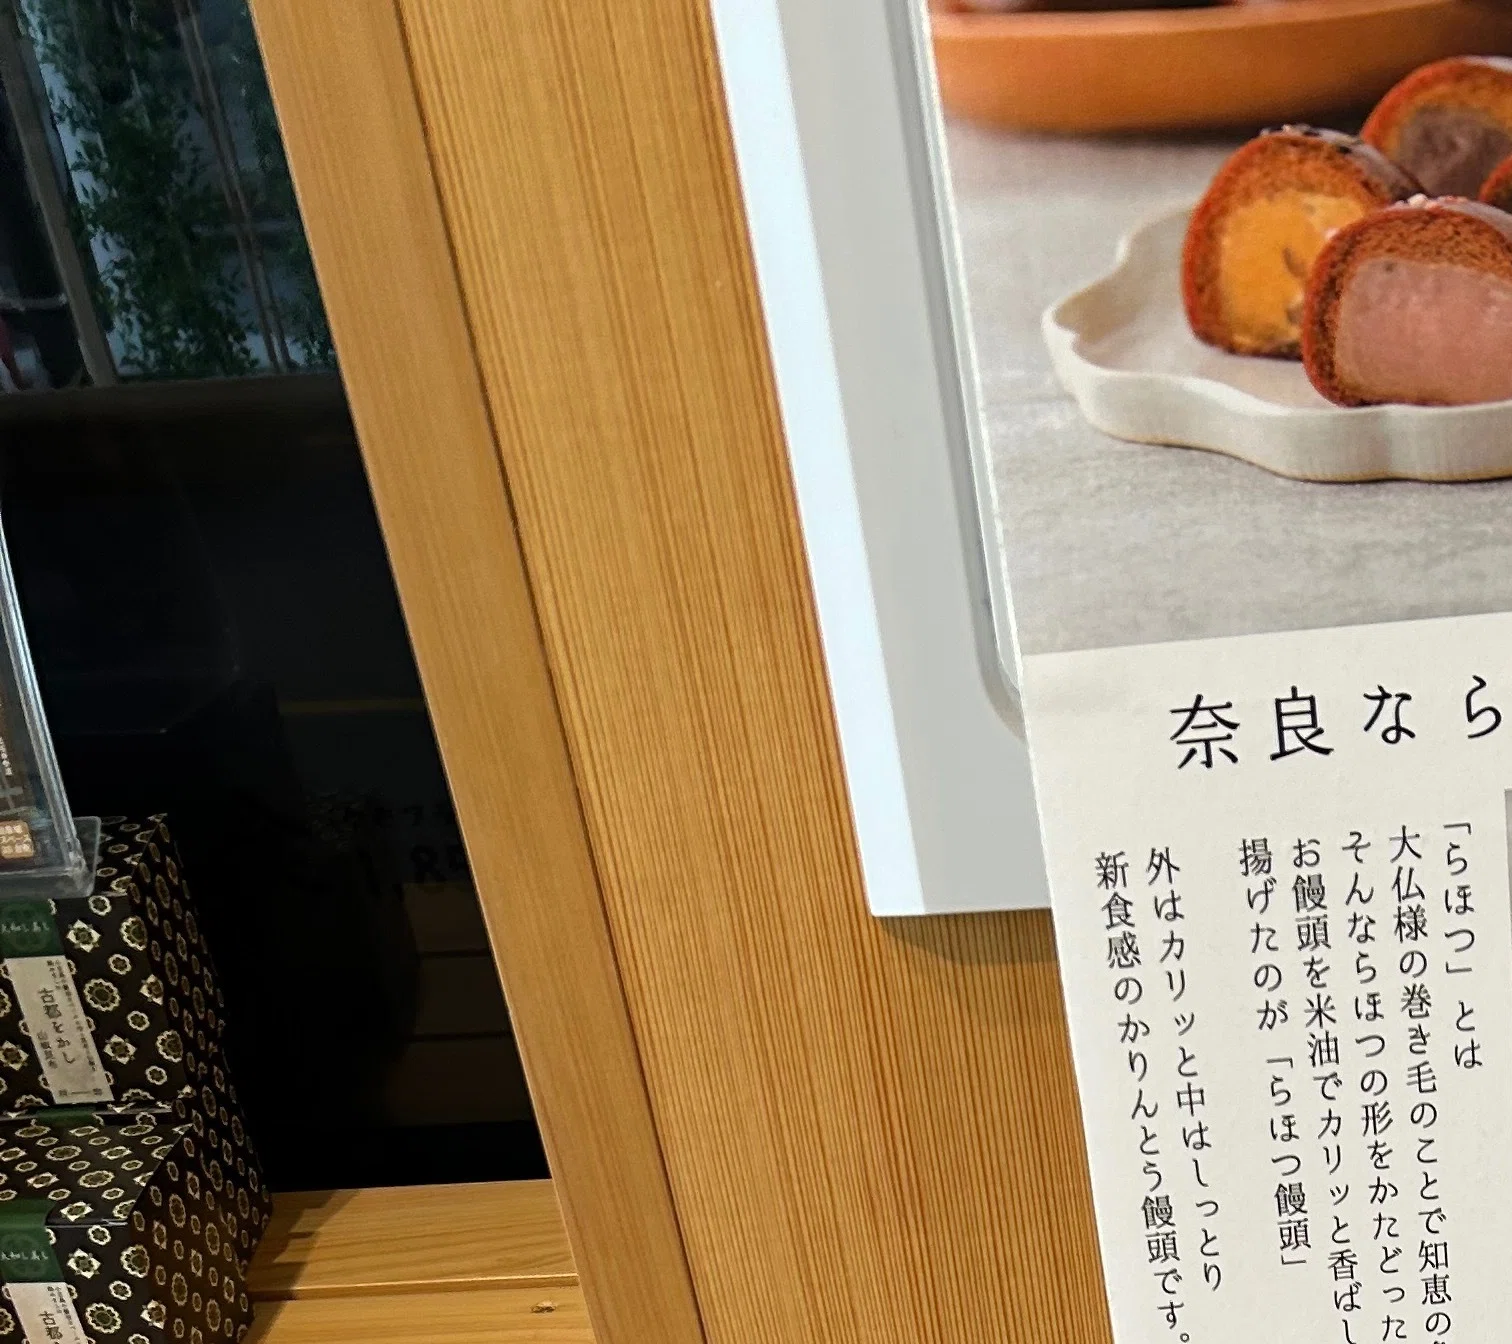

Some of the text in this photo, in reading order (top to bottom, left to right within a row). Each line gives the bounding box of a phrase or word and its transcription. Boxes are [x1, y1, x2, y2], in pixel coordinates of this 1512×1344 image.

[1094, 849, 1192, 1344] 新食感のかりんとう饅頭です。
[1144, 846, 1224, 1294] 外はカリッと中はしっとり
[1239, 836, 1311, 1269] 揚げたのが「らほつ饅頭」
[1340, 830, 1409, 1343] そんならほつの形をかたどった
[1443, 818, 1485, 1071] 「らほつ」とは
